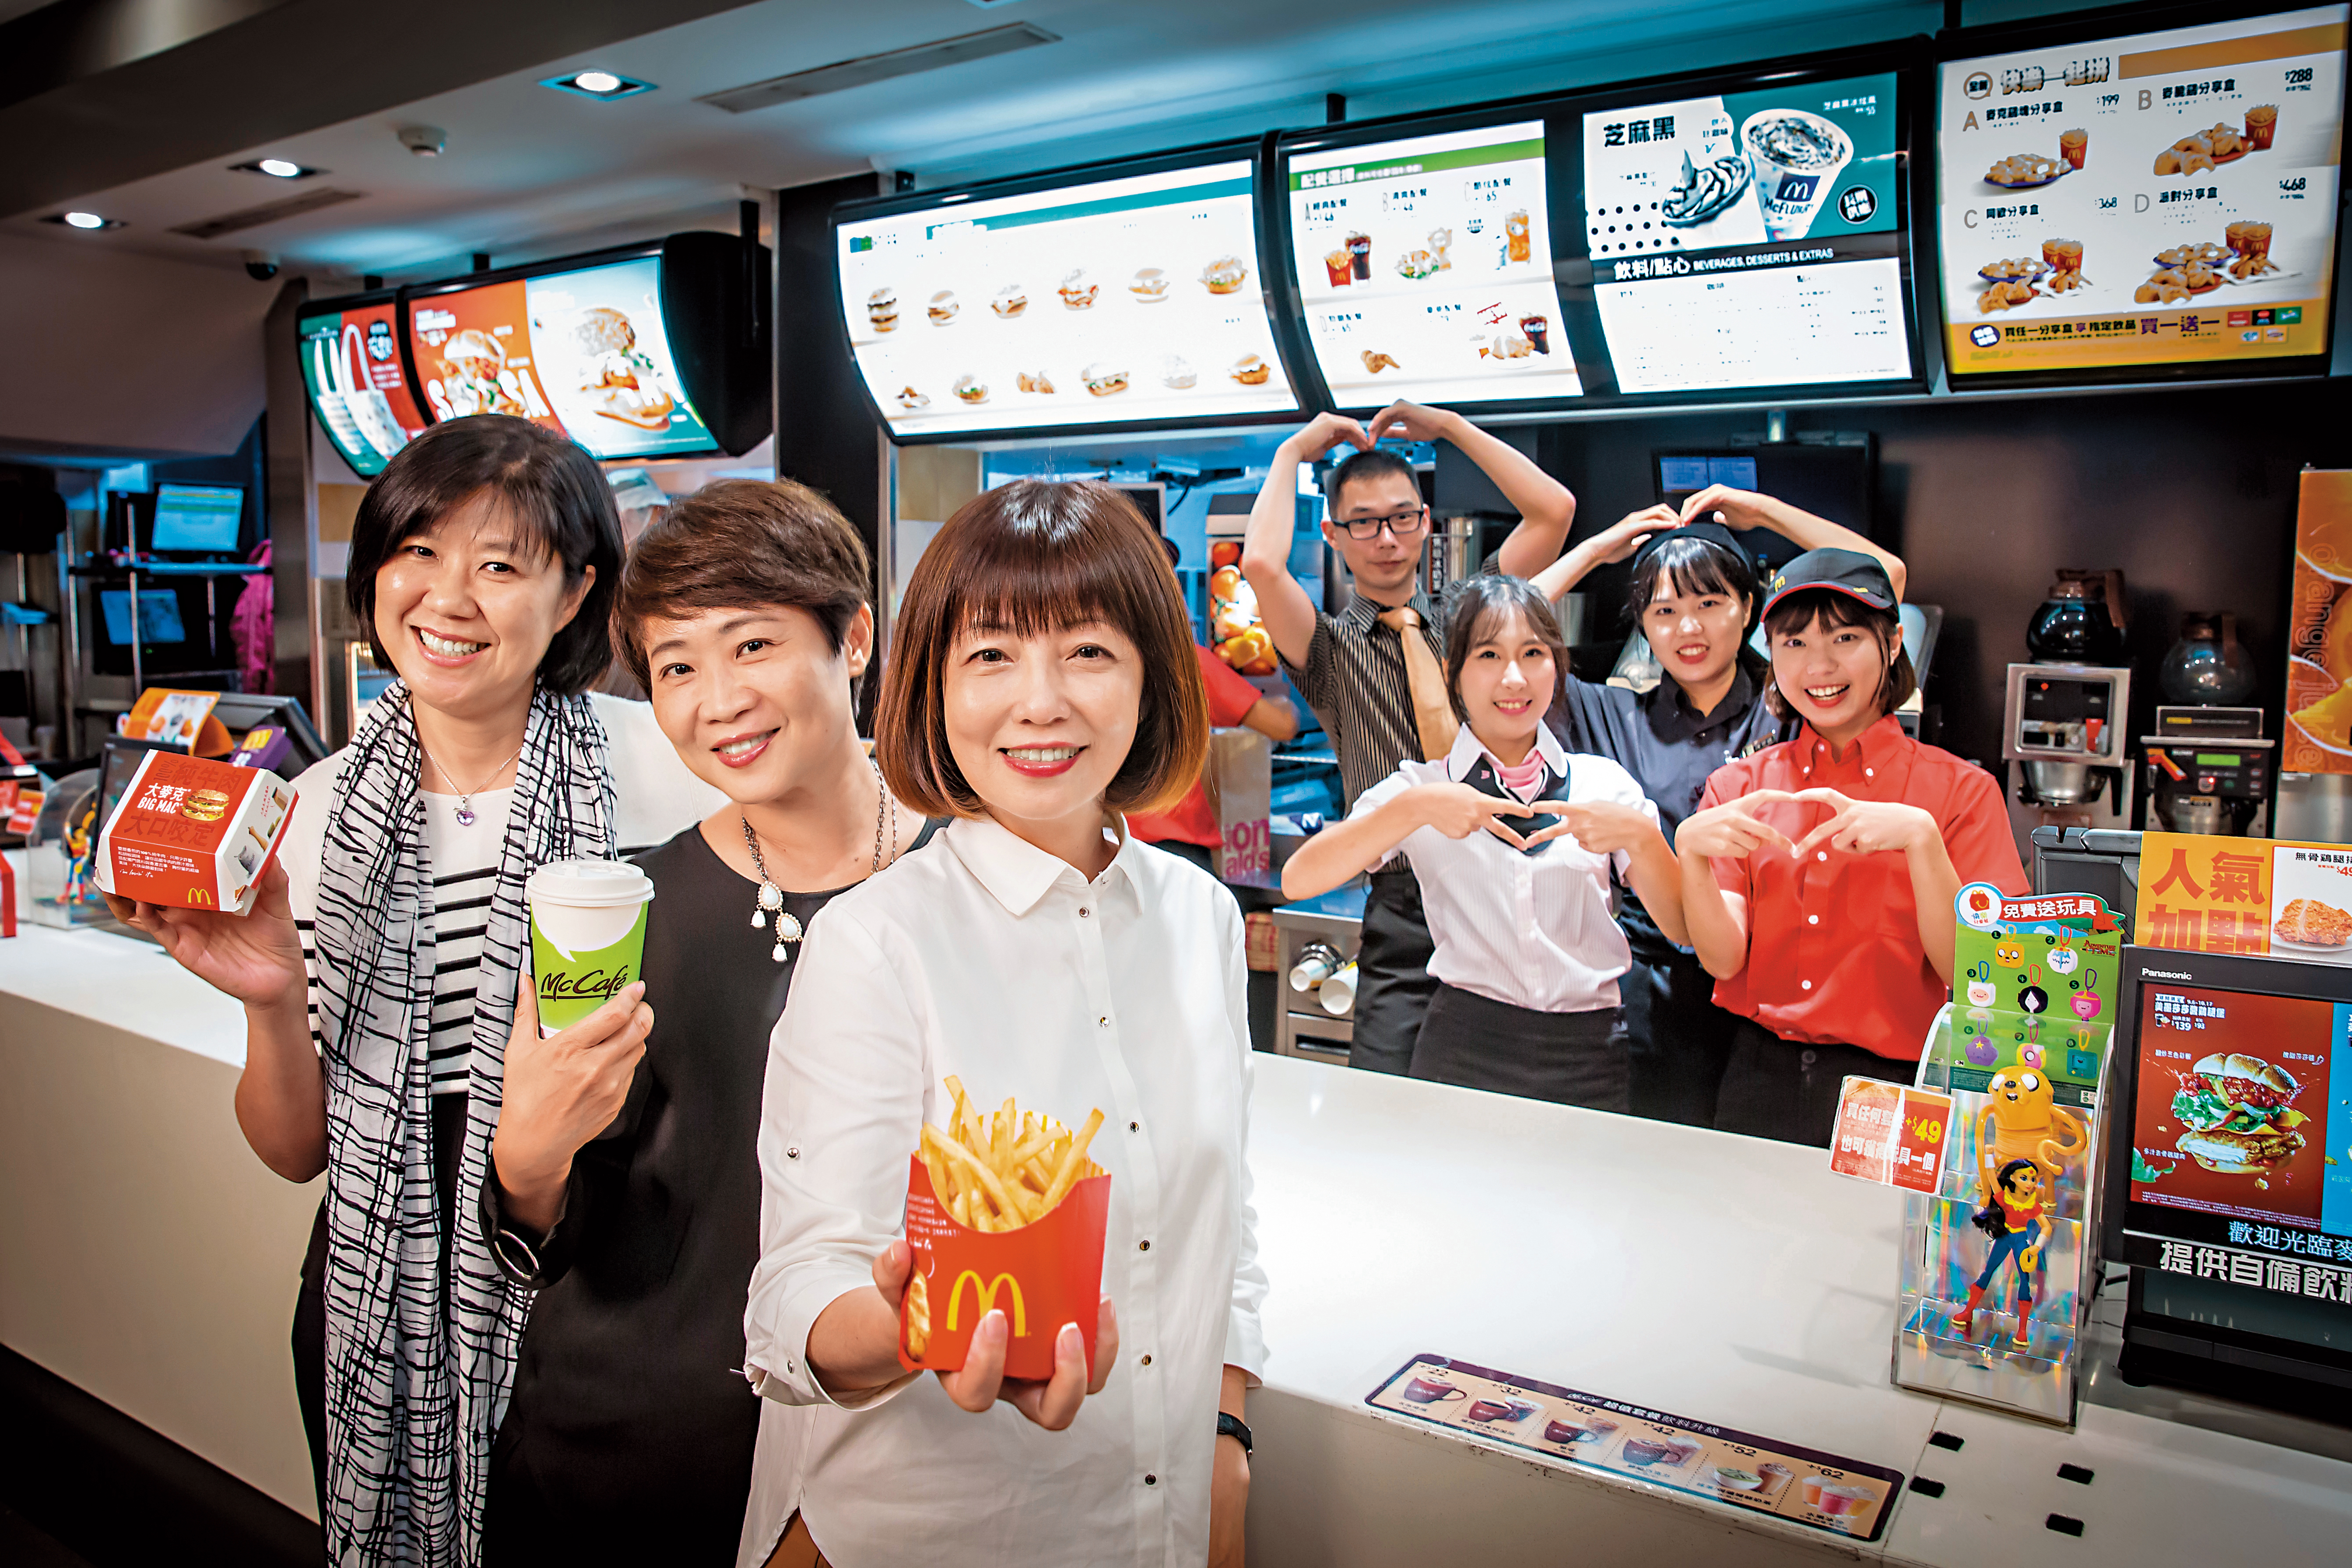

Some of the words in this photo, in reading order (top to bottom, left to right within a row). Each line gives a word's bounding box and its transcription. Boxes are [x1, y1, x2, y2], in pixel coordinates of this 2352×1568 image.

[2285, 67, 2313, 83] $288
[2138, 89, 2151, 110] B
[1963, 111, 1979, 131] A
[1604, 115, 1675, 148] 芝麻黑
[2134, 194, 2150, 213] D
[1964, 209, 1978, 229] C
[1746, 252, 1790, 266] DESSERTS
[1792, 251, 1798, 262] &
[1799, 248, 1834, 261] EXTRAS
[1614, 256, 1691, 281] 飲料/點心
[2140, 316, 2220, 334] 買一送一
[137, 797, 157, 810] BIG
[124, 812, 215, 847] 大口咬定
[2150, 848, 2266, 904] 人氣
[2003, 899, 2097, 919] 免費送玩具
[2148, 903, 2263, 954] 加點
[2083, 940, 2116, 951] ADVENTURE
[541, 965, 628, 1001] McCafé
[2142, 967, 2192, 980] Panasonic
[2172, 1020, 2191, 1031] $139
